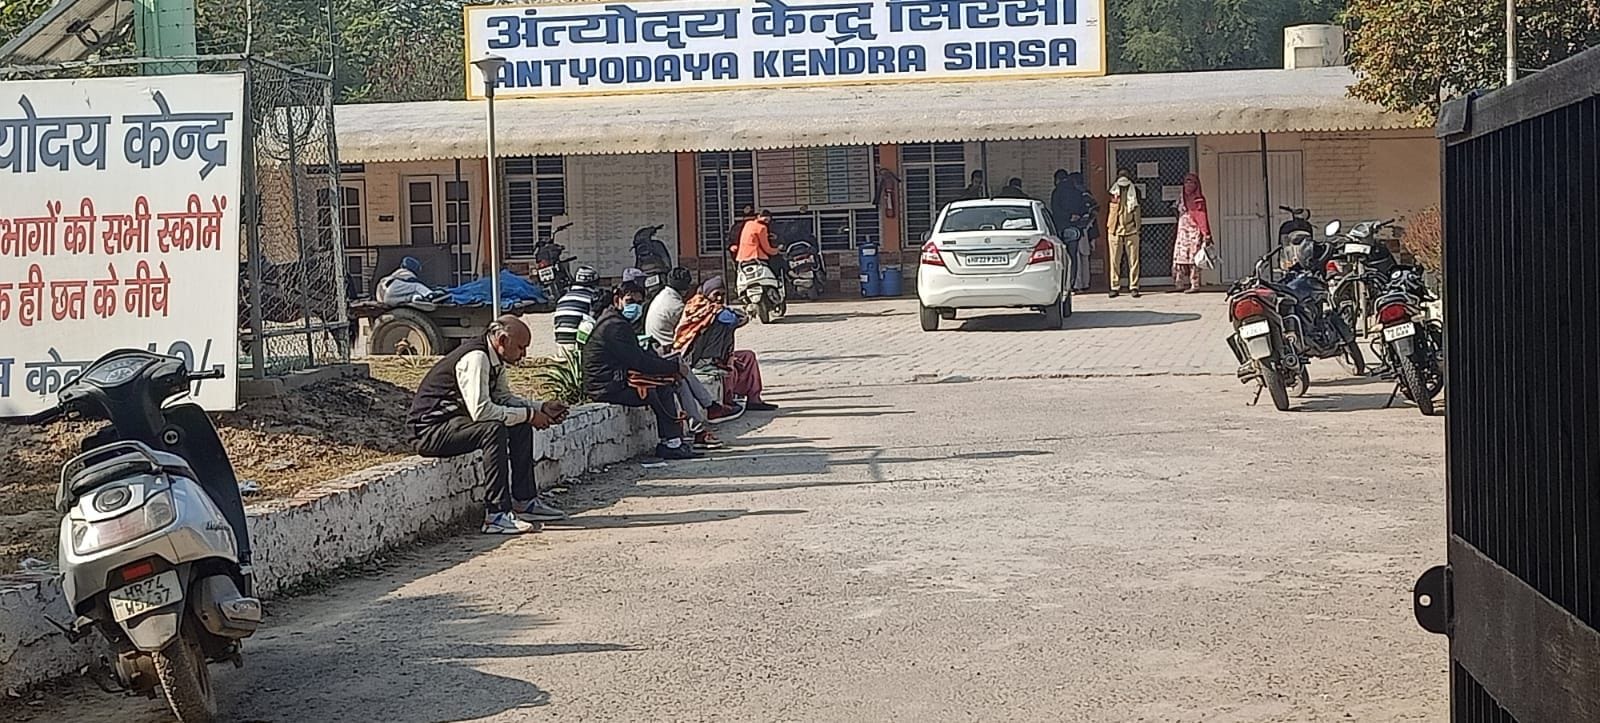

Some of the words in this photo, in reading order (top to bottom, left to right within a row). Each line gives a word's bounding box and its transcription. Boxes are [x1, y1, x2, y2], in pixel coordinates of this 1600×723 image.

[486, 4, 741, 49] अंत्योदय
[752, 0, 877, 45] केन्द्र
[496, 51, 739, 88] ANTYODAYA
[753, 44, 927, 78] KENDRA
[943, 37, 1077, 71] SIRSA
[122, 90, 233, 181] केन्द्र
[63, 197, 97, 255] की
[102, 195, 151, 255] सभी
[157, 194, 227, 253] स्कीमें
[18, 263, 45, 327] ही
[50, 280, 88, 321] छत
[93, 262, 119, 320] के
[124, 259, 171, 318] नीचे
